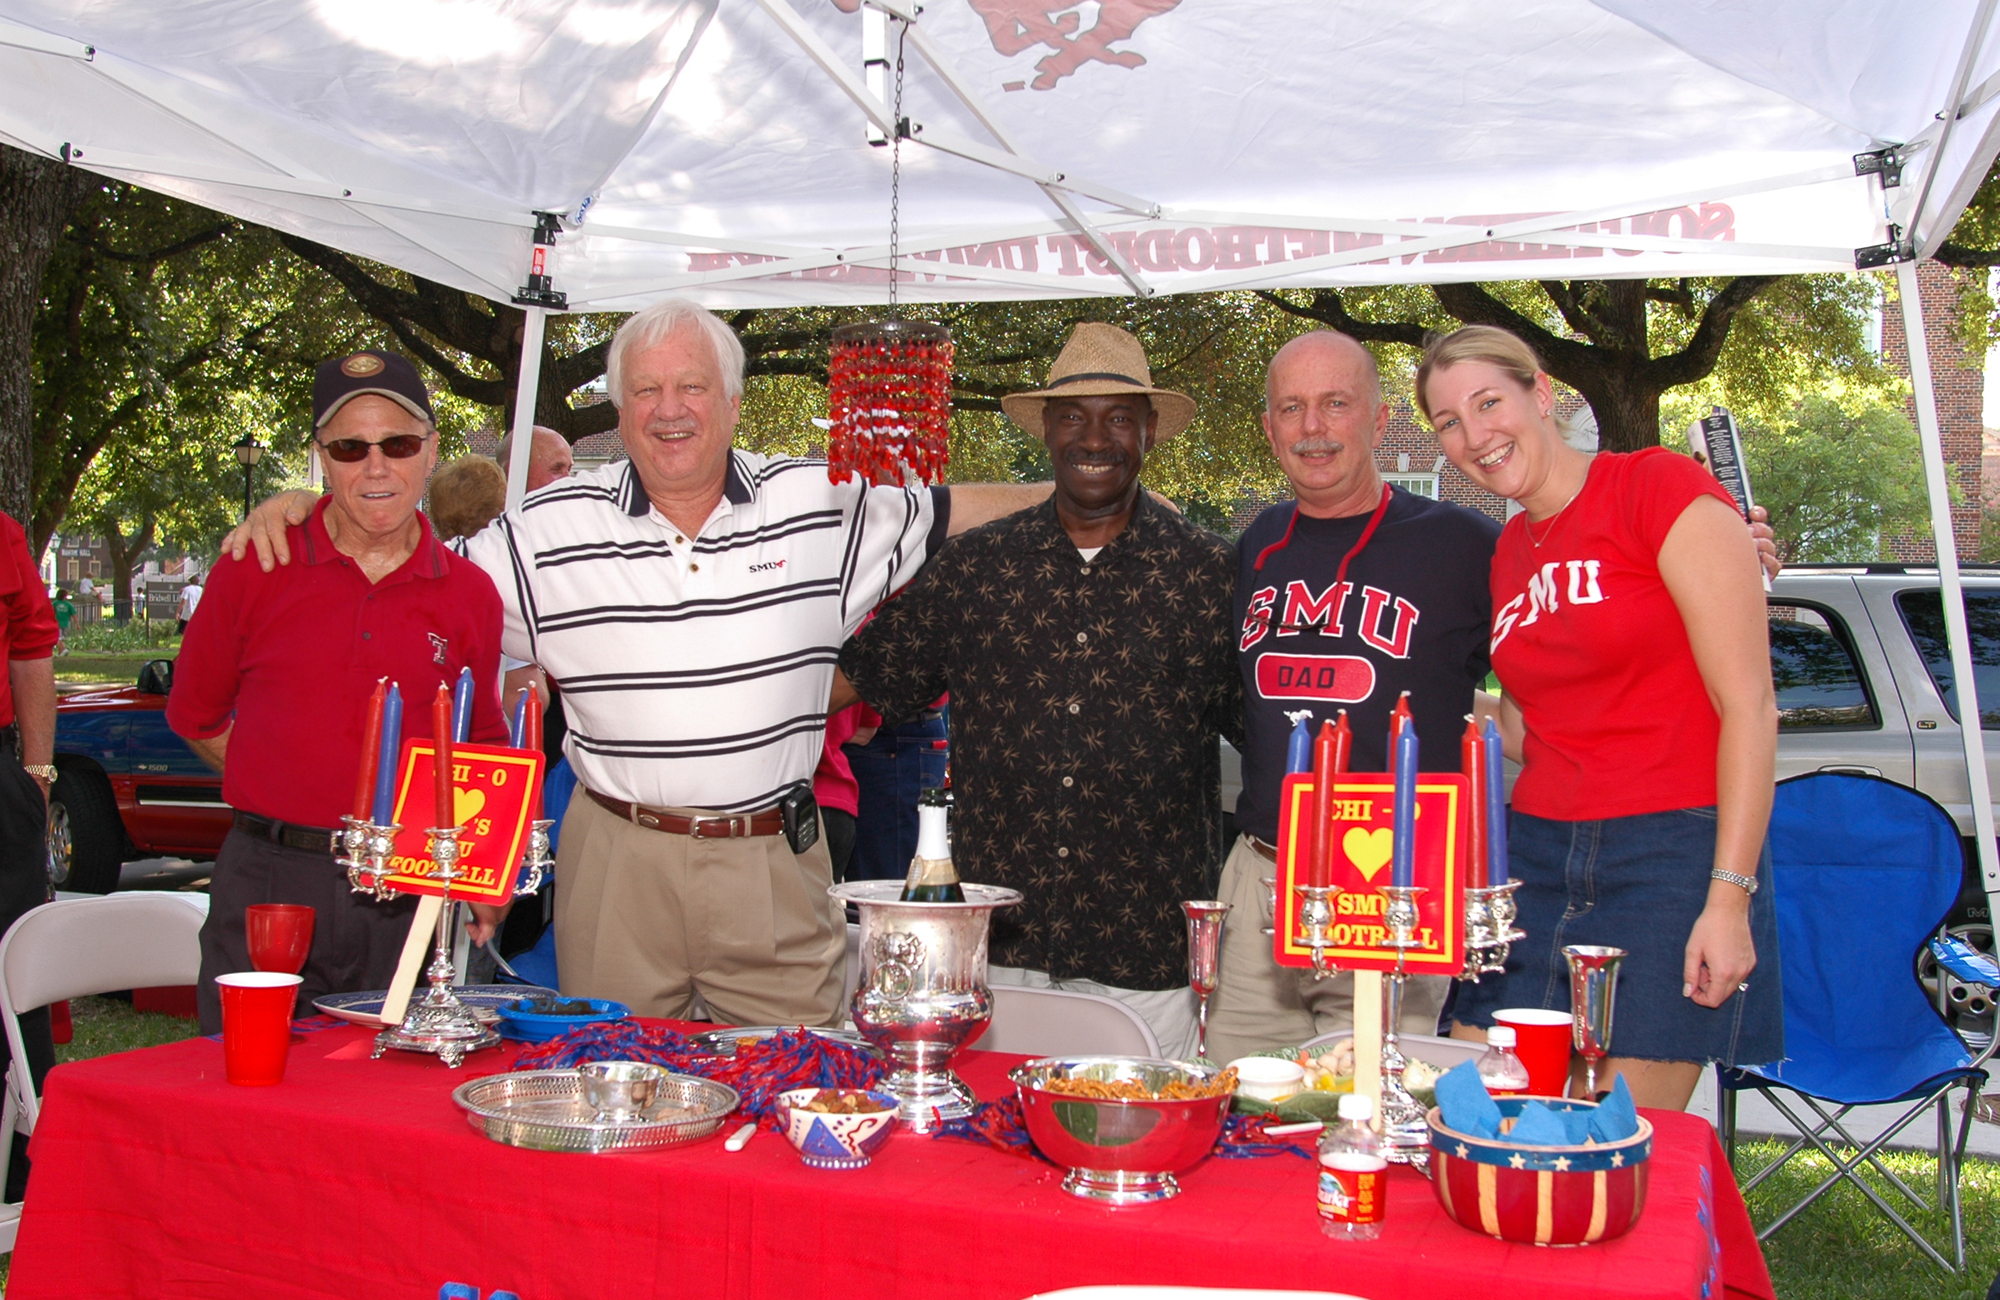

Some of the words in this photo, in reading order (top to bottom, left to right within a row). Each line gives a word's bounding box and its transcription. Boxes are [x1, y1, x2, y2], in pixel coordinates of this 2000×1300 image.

[749, 561, 777, 573] SMU
[1490, 560, 1604, 655] SMU
[1239, 580, 1420, 659] SMU
[1278, 665, 1335, 689] DAD
[433, 764, 472, 783] HI
[1332, 799, 1374, 821] CHI
[424, 838, 475, 858] SU
[388, 856, 496, 886] FOOTALL
